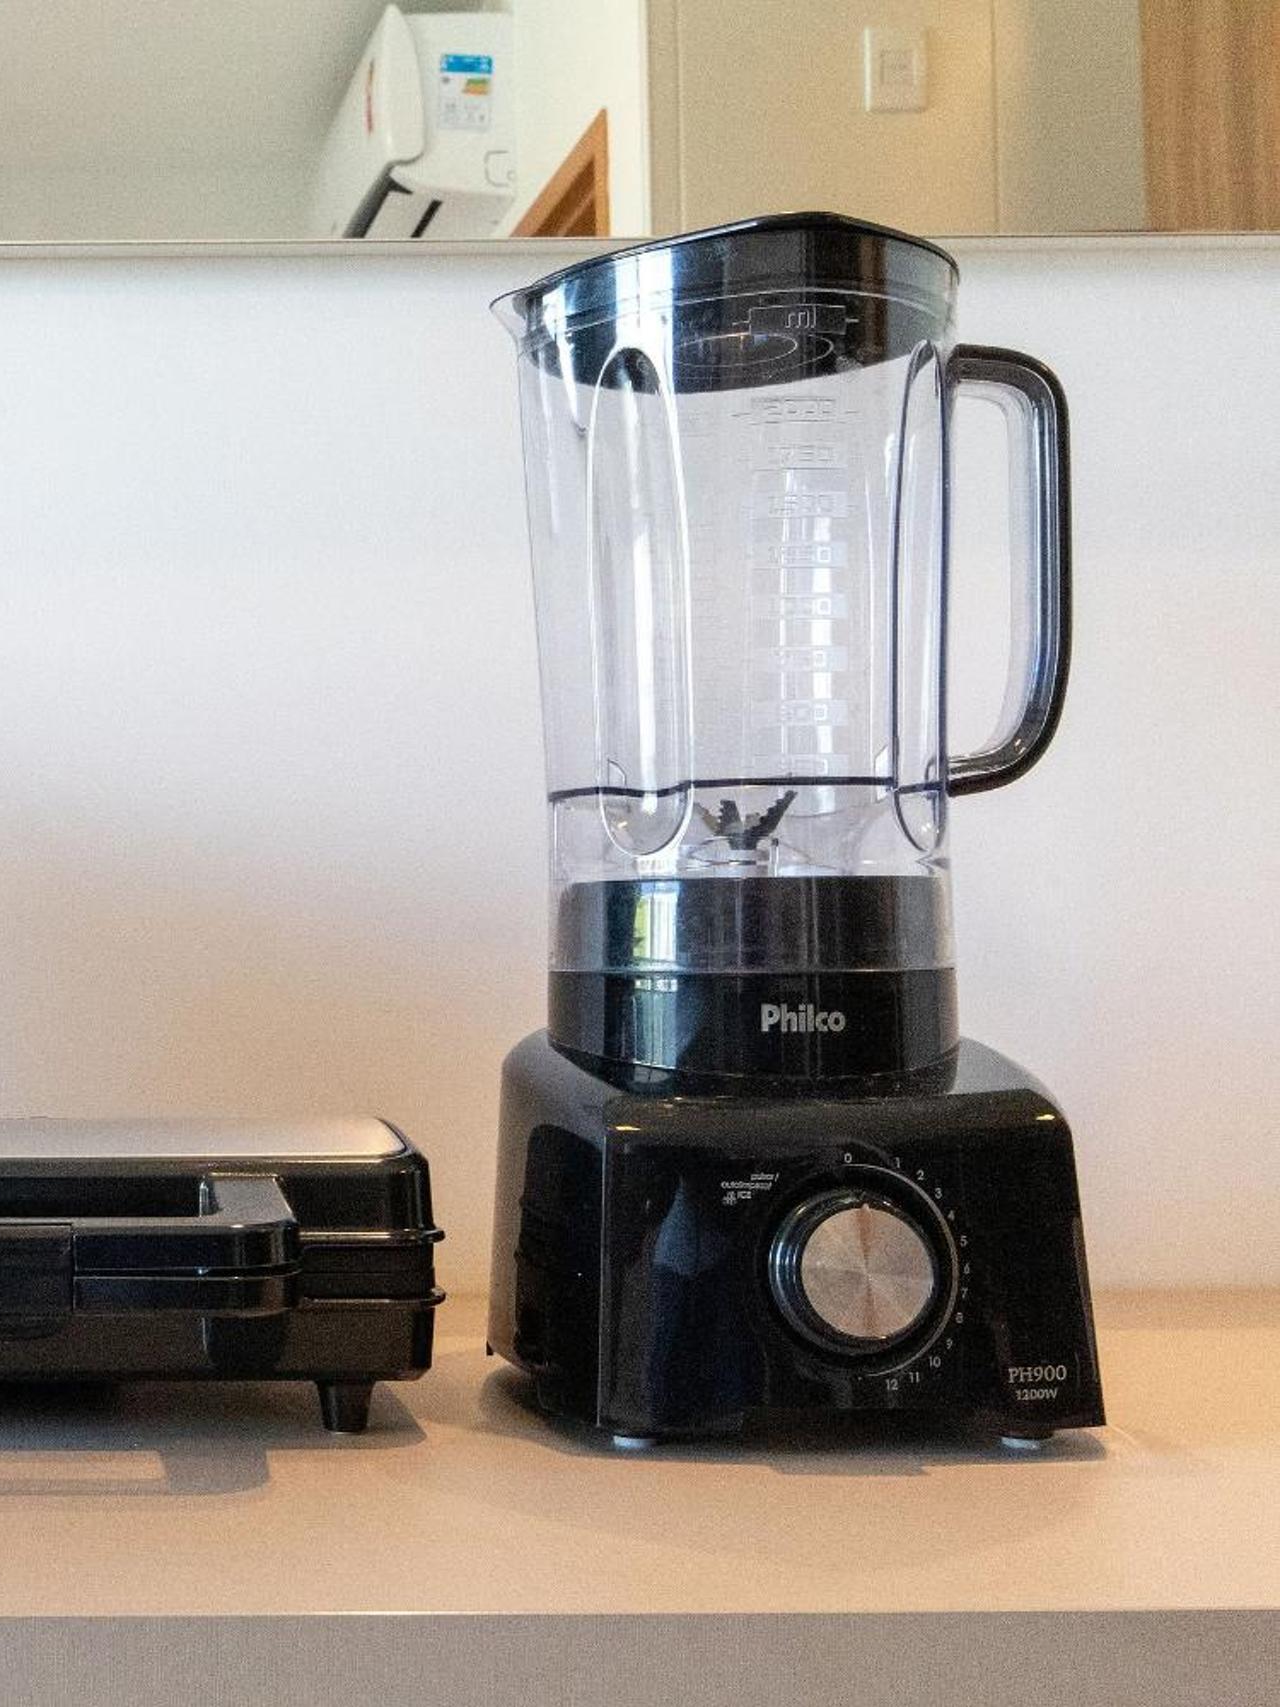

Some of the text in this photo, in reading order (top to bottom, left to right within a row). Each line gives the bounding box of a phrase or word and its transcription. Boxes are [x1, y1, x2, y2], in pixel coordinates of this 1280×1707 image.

[760, 1003, 846, 1032] Philco
[843, 1152, 853, 1164] 0
[893, 1156, 902, 1169] 1
[916, 1169, 926, 1181] 2
[934, 1187, 943, 1200] 3
[946, 1209, 956, 1222] 4
[959, 1235, 969, 1247] 5
[963, 1263, 971, 1274] 6
[960, 1286, 969, 1299] 7
[955, 1311, 964, 1324] 8
[945, 1337, 954, 1350] 9
[928, 1356, 942, 1368] 10
[908, 1371, 920, 1383] 11
[1007, 1364, 1068, 1384] PH900
[885, 1378, 899, 1391] 12
[1014, 1386, 1060, 1401] 1200W
